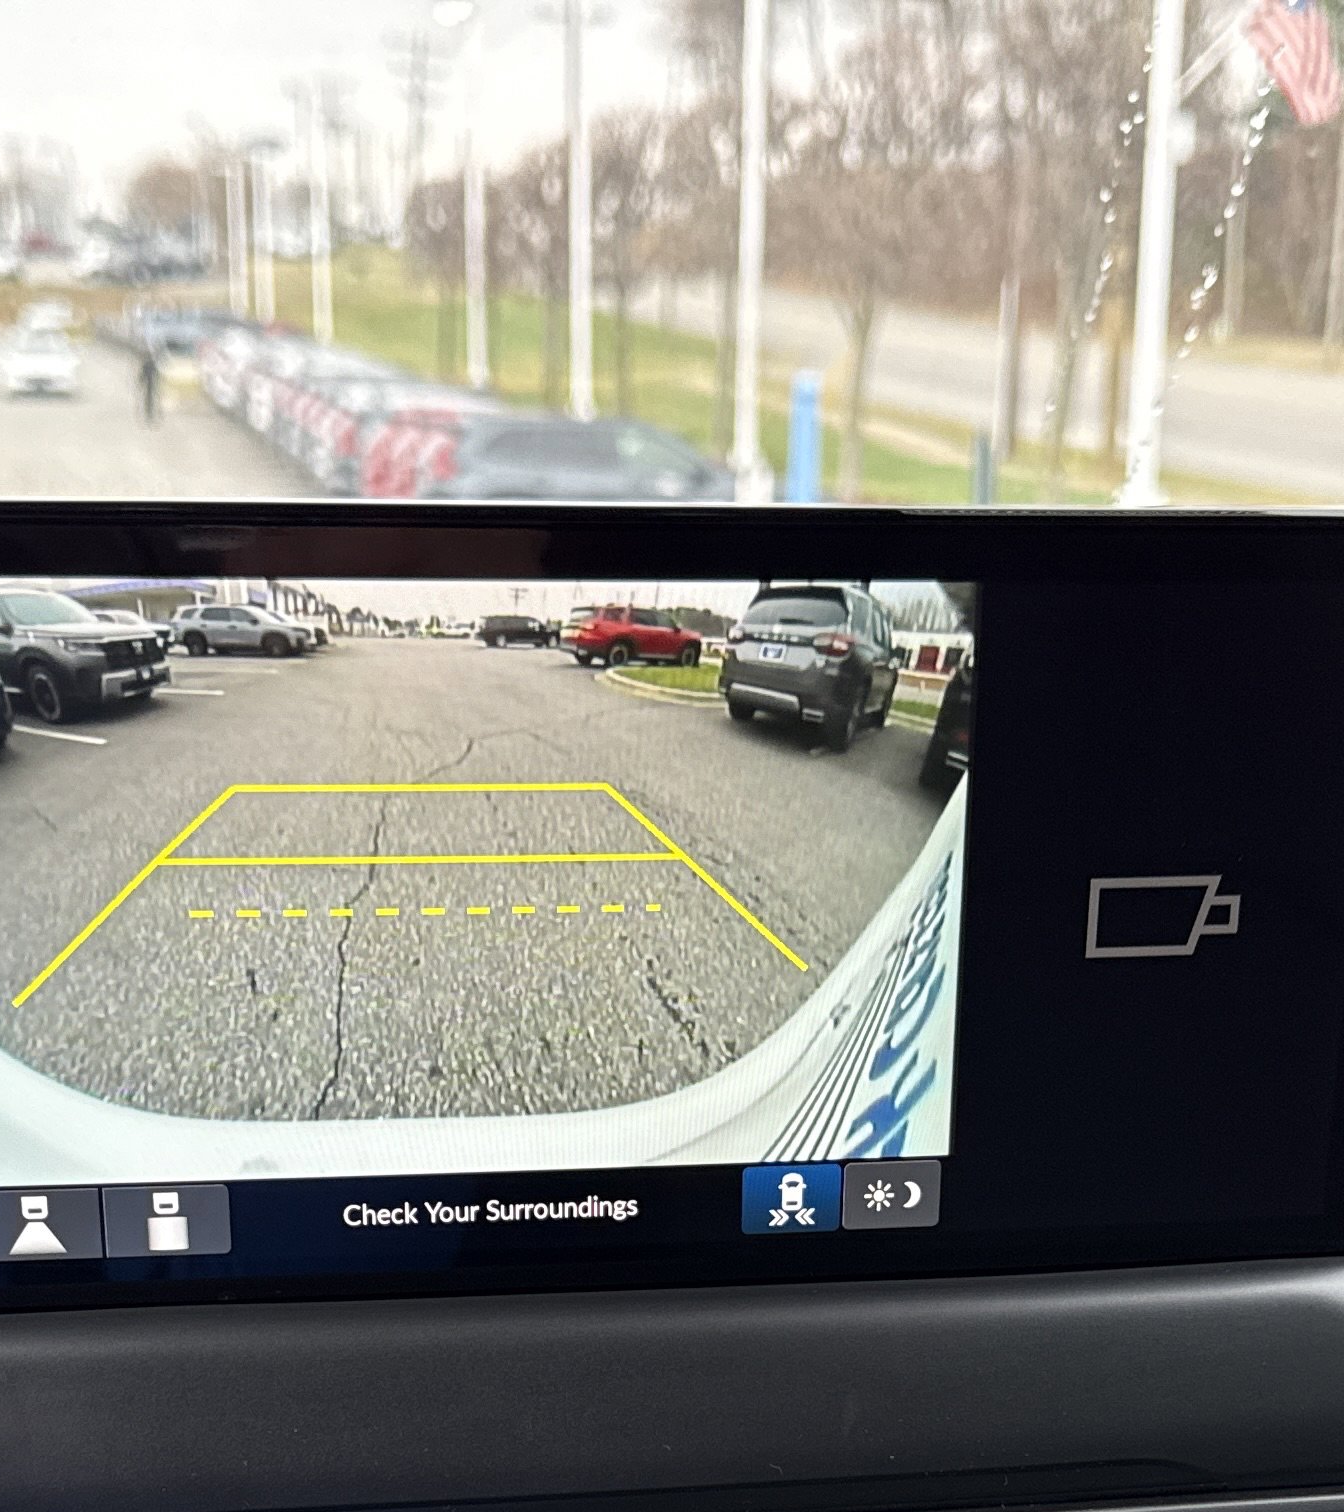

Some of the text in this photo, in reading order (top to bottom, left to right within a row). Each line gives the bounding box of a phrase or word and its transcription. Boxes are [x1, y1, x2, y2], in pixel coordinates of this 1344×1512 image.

[342, 1194, 638, 1226] Check Your Surroundings
